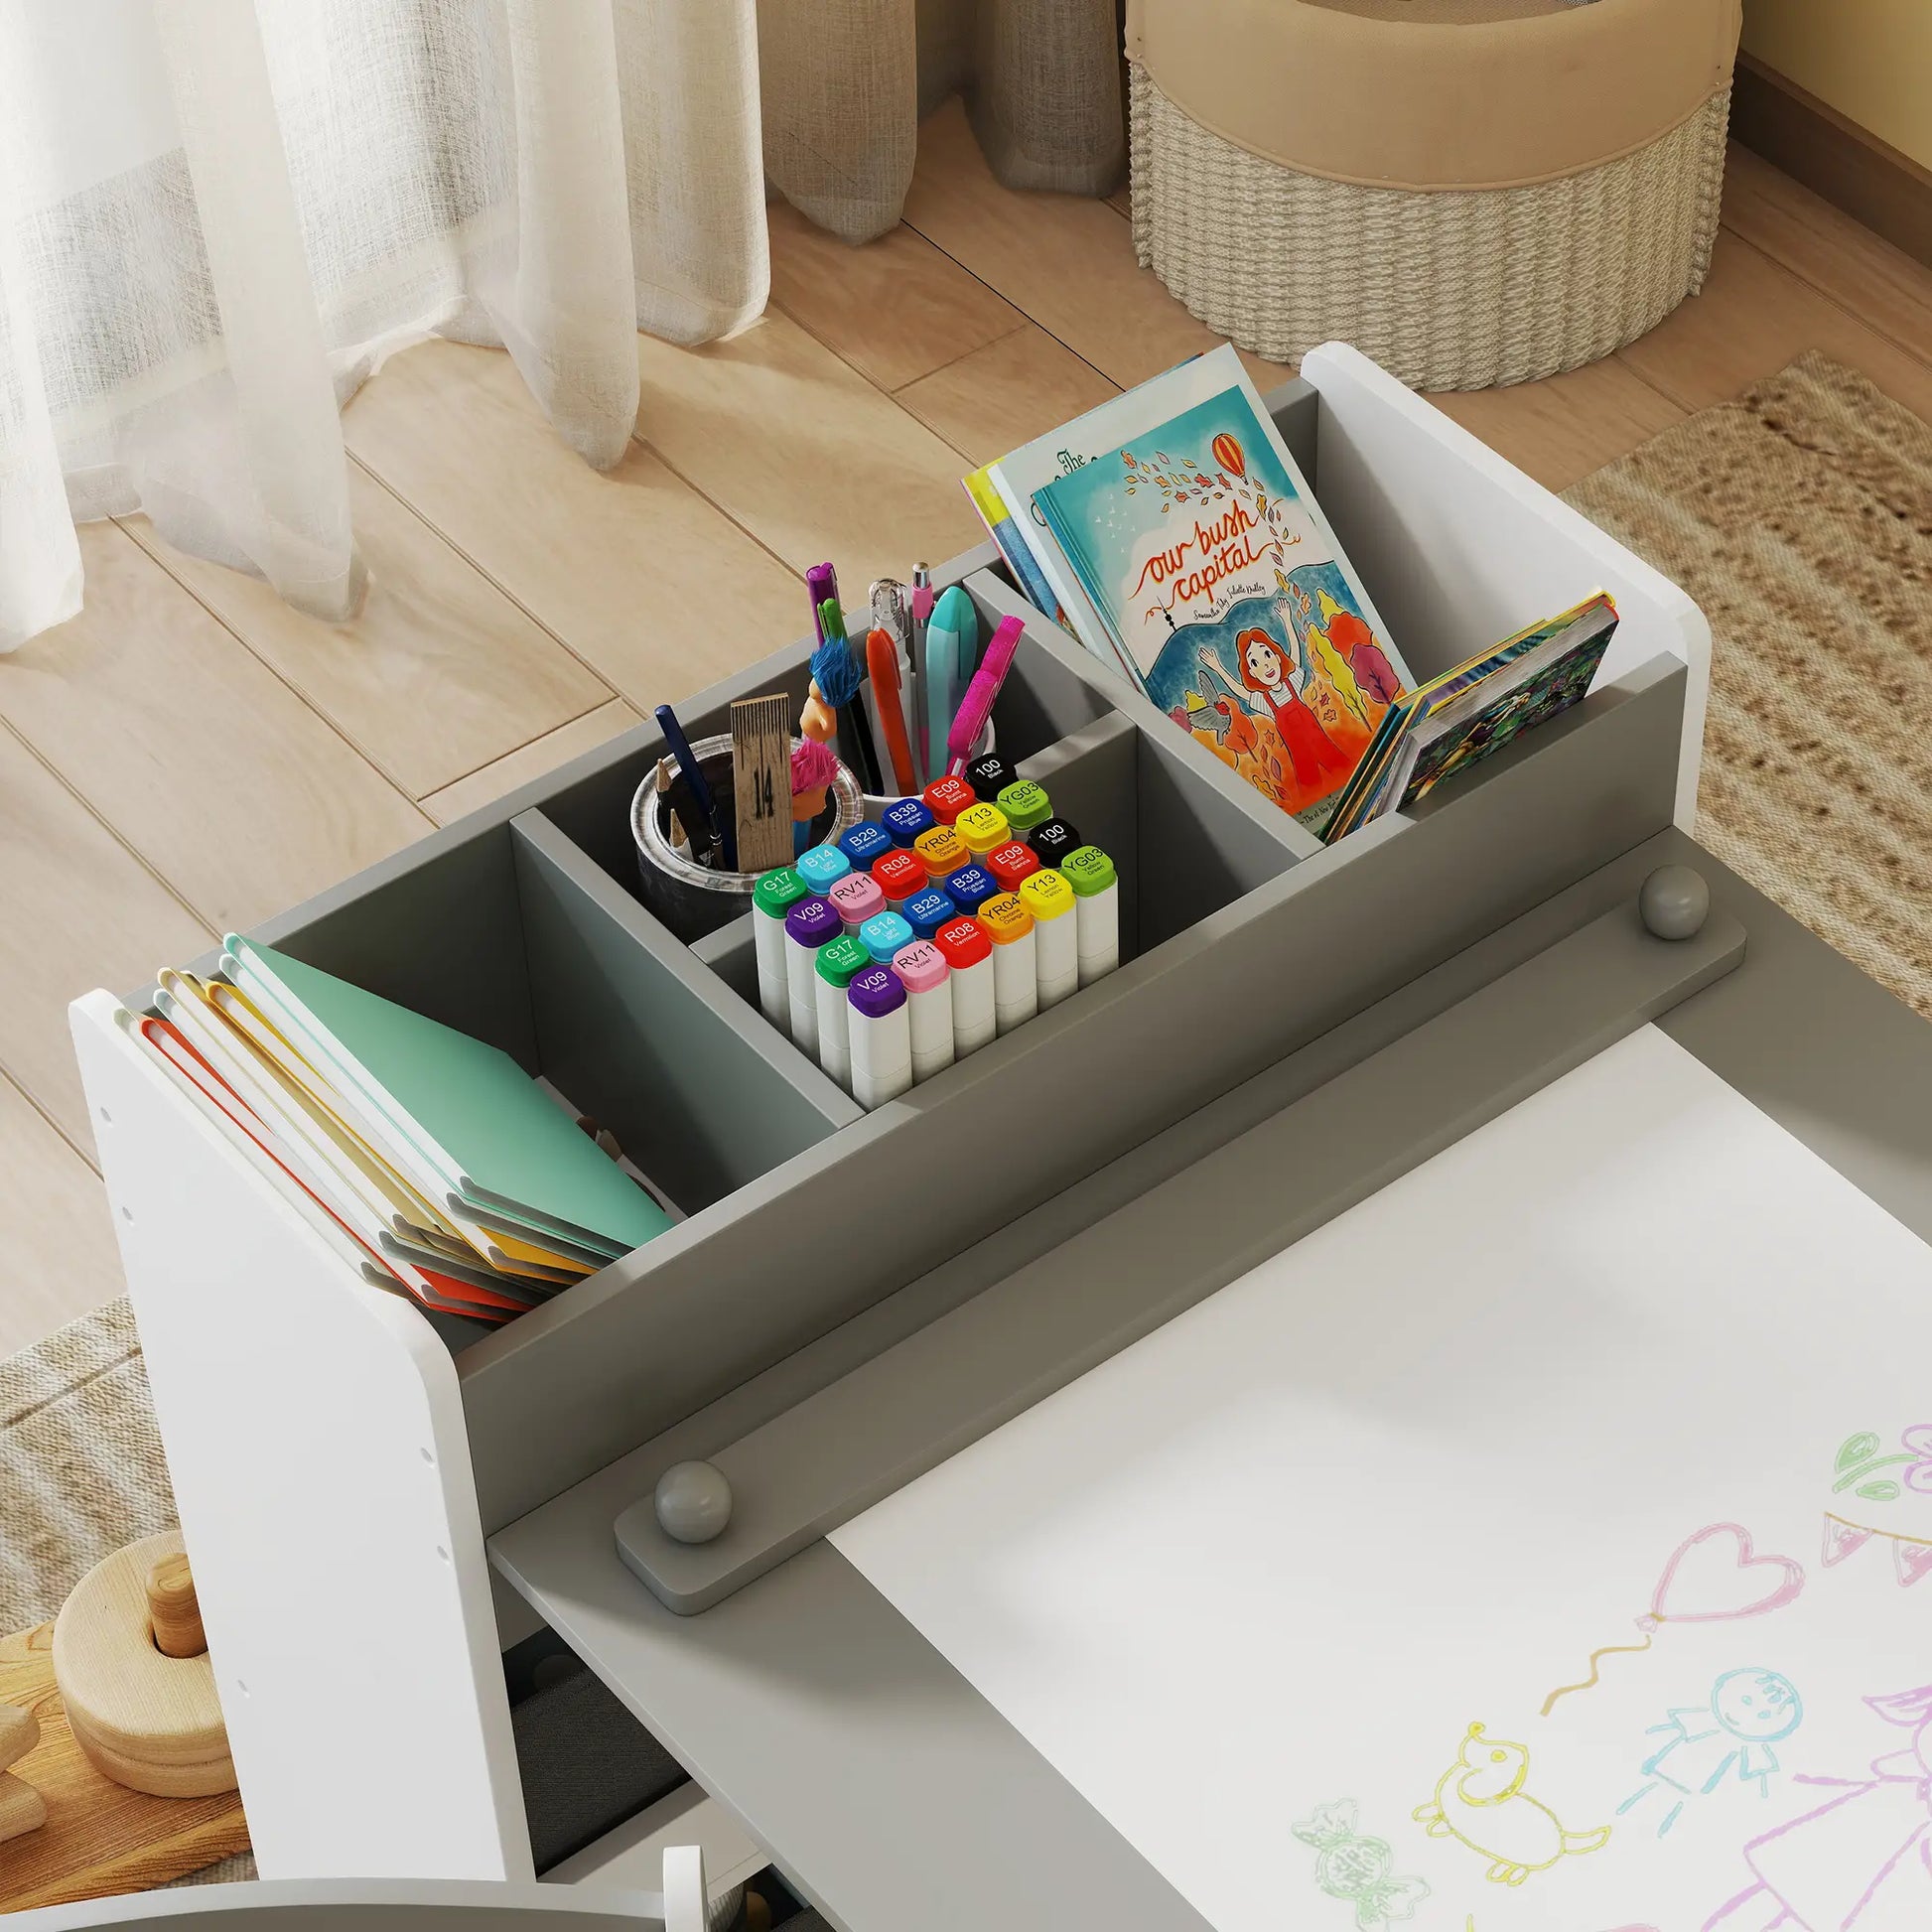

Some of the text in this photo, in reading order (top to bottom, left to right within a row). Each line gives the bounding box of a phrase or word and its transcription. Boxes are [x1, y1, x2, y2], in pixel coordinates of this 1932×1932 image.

[1056, 449, 1086, 475] The
[1194, 499, 1260, 555] bush
[975, 759, 1001, 776] 100
[987, 768, 1004, 779] Black
[754, 764, 773, 820] 14
[932, 779, 960, 798] E09
[1001, 782, 1039, 806] YG03
[889, 803, 917, 822] B39
[898, 811, 923, 826] Prussian
[908, 817, 921, 827] Blue
[962, 807, 992, 825] Y13
[849, 828, 878, 847] B29
[918, 829, 956, 852] YR04
[1038, 824, 1064, 842] 100
[1050, 834, 1067, 845] Black
[854, 834, 886, 853] Ultramarine
[804, 849, 833, 868] B14
[994, 845, 1024, 865] E09
[1009, 856, 1026, 866] Burnt
[1012, 858, 1032, 871] Sienna
[1064, 849, 1103, 872] YG03
[881, 855, 910, 875] R08
[762, 872, 790, 891] G17
[834, 877, 872, 900] RV11
[952, 869, 981, 889] B39
[962, 878, 987, 893] Prussian
[1027, 874, 1056, 893] Y13
[778, 887, 796, 897] Green
[851, 890, 868, 900] Violet
[971, 884, 986, 894] Blue
[794, 902, 824, 920] V09
[911, 895, 940, 913] B29
[918, 901, 949, 920] Ultramarine
[982, 897, 1021, 920] YR04
[808, 912, 826, 923] Violet
[867, 916, 896, 936] B14
[1003, 912, 1025, 925] Orange
[944, 922, 974, 942] R08
[954, 931, 980, 946] Vermilion
[825, 939, 853, 959] G17
[897, 945, 935, 969] RV11
[841, 954, 860, 966] Green
[914, 958, 931, 969] Violet
[857, 971, 888, 990] V09
[872, 982, 890, 993] Violet
